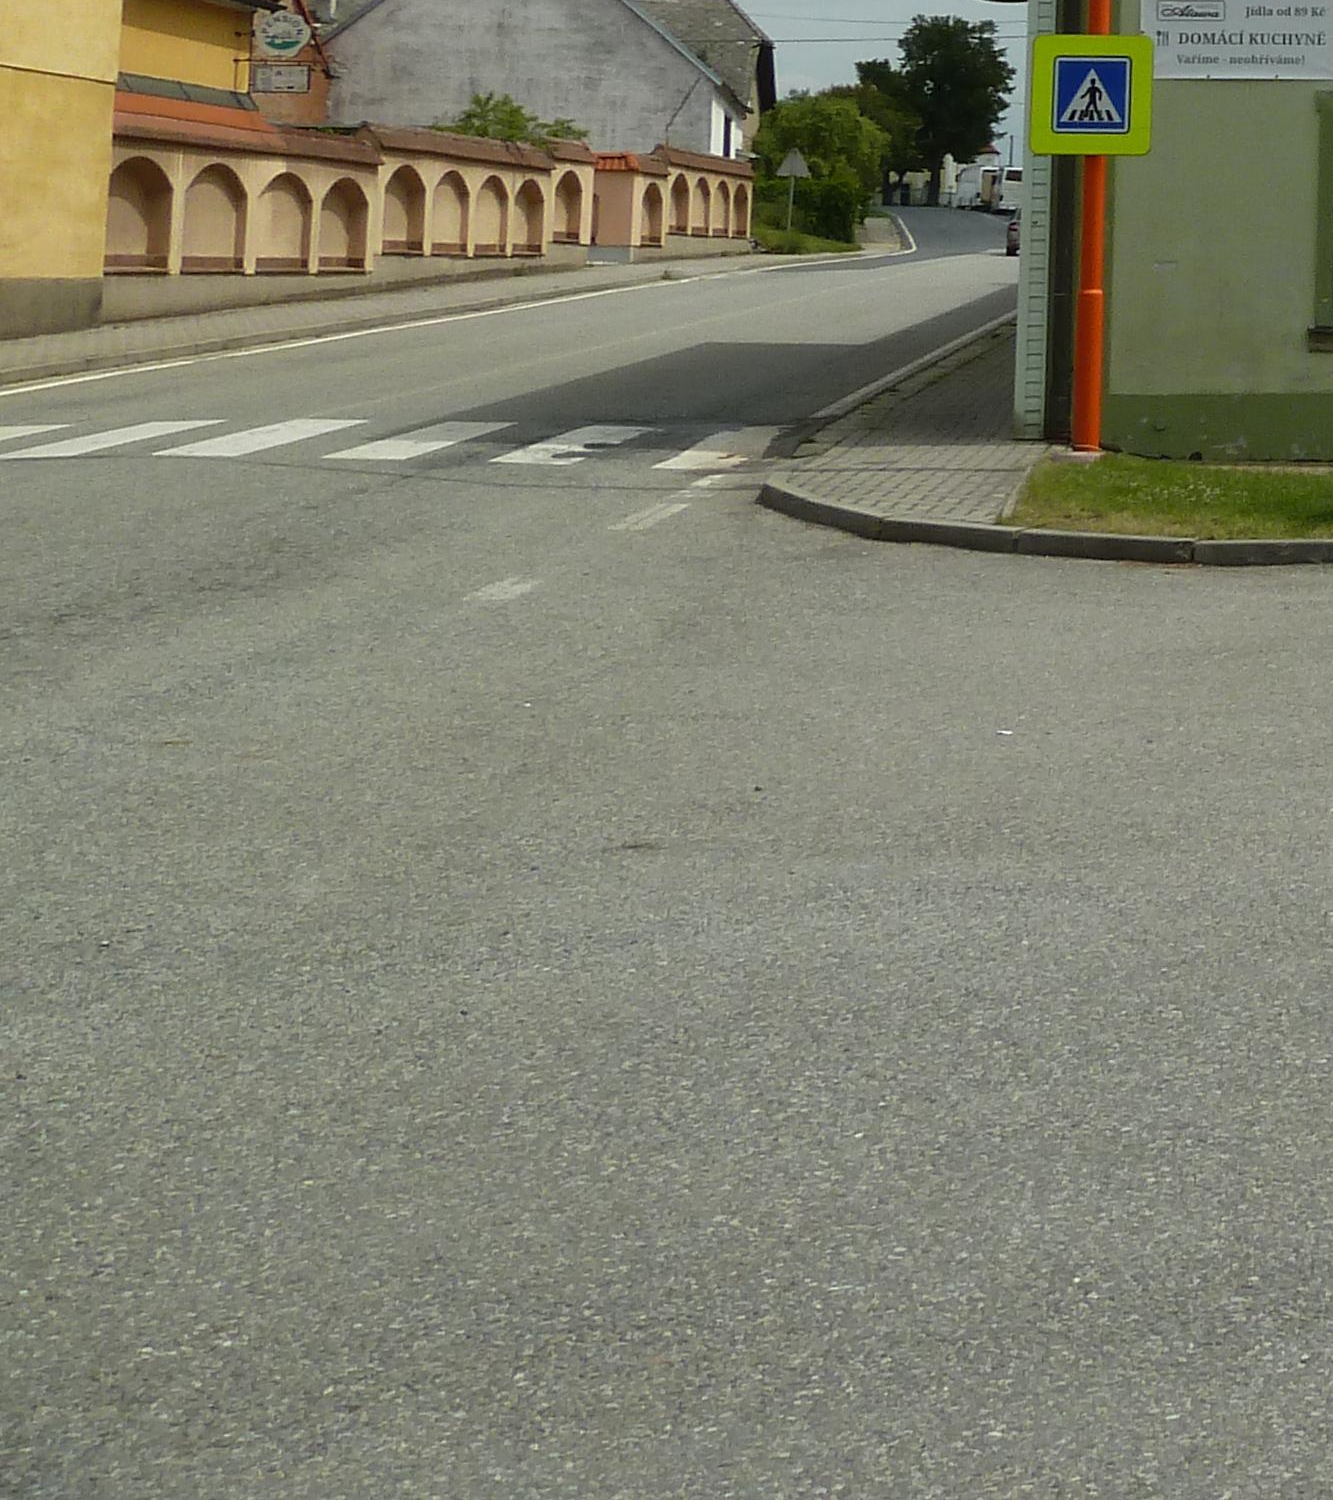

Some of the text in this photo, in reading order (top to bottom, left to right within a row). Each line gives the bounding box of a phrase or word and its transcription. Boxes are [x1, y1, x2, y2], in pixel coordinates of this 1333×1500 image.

[1245, 6, 1273, 18] Jídla
[1276, 6, 1291, 17] od
[1294, 7, 1308, 17] 89
[1178, 30, 1326, 46] DOMÁCÍ KUCHYNĚ
